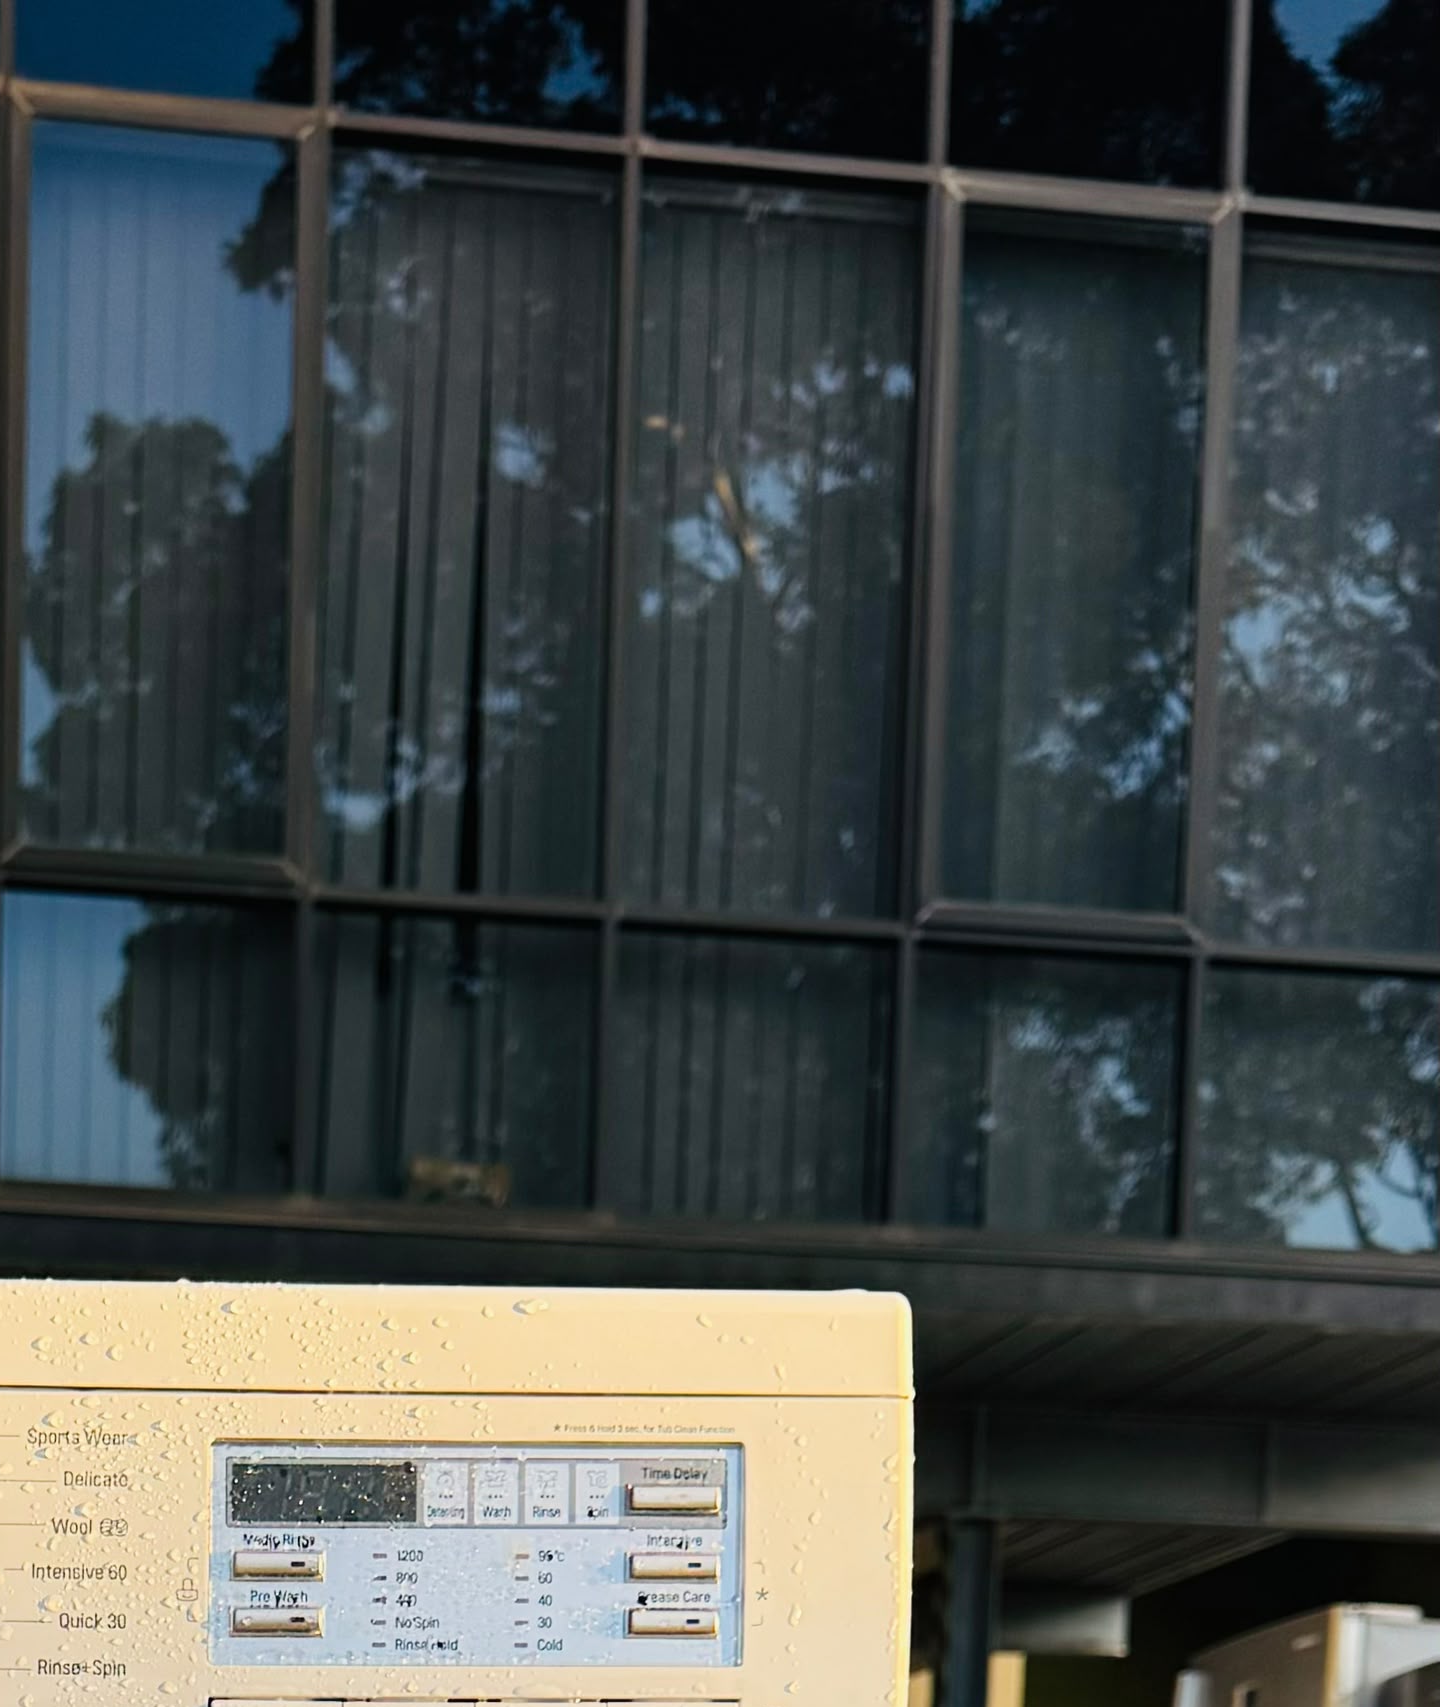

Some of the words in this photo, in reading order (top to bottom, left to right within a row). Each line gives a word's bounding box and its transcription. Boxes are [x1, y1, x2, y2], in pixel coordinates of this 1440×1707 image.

[27, 1428, 80, 1446] Sports
[83, 1428, 128, 1446] Wear
[64, 1471, 128, 1487] Delicate
[641, 1467, 670, 1480] Time
[674, 1467, 708, 1481] Delay
[482, 1505, 511, 1518] Wash
[532, 1505, 561, 1518] Rinse
[51, 1518, 92, 1535] Wool
[396, 1550, 424, 1562] 1200
[32, 1563, 103, 1580] Intensive
[108, 1564, 127, 1581] 60
[538, 1572, 553, 1584] 60
[538, 1594, 553, 1606] 40
[683, 1591, 711, 1603] Care
[59, 1612, 103, 1631] Quick
[107, 1613, 126, 1629] 30
[395, 1617, 412, 1628] No
[413, 1616, 439, 1630] Spin
[537, 1617, 552, 1628] 30
[537, 1639, 563, 1651] Cold
